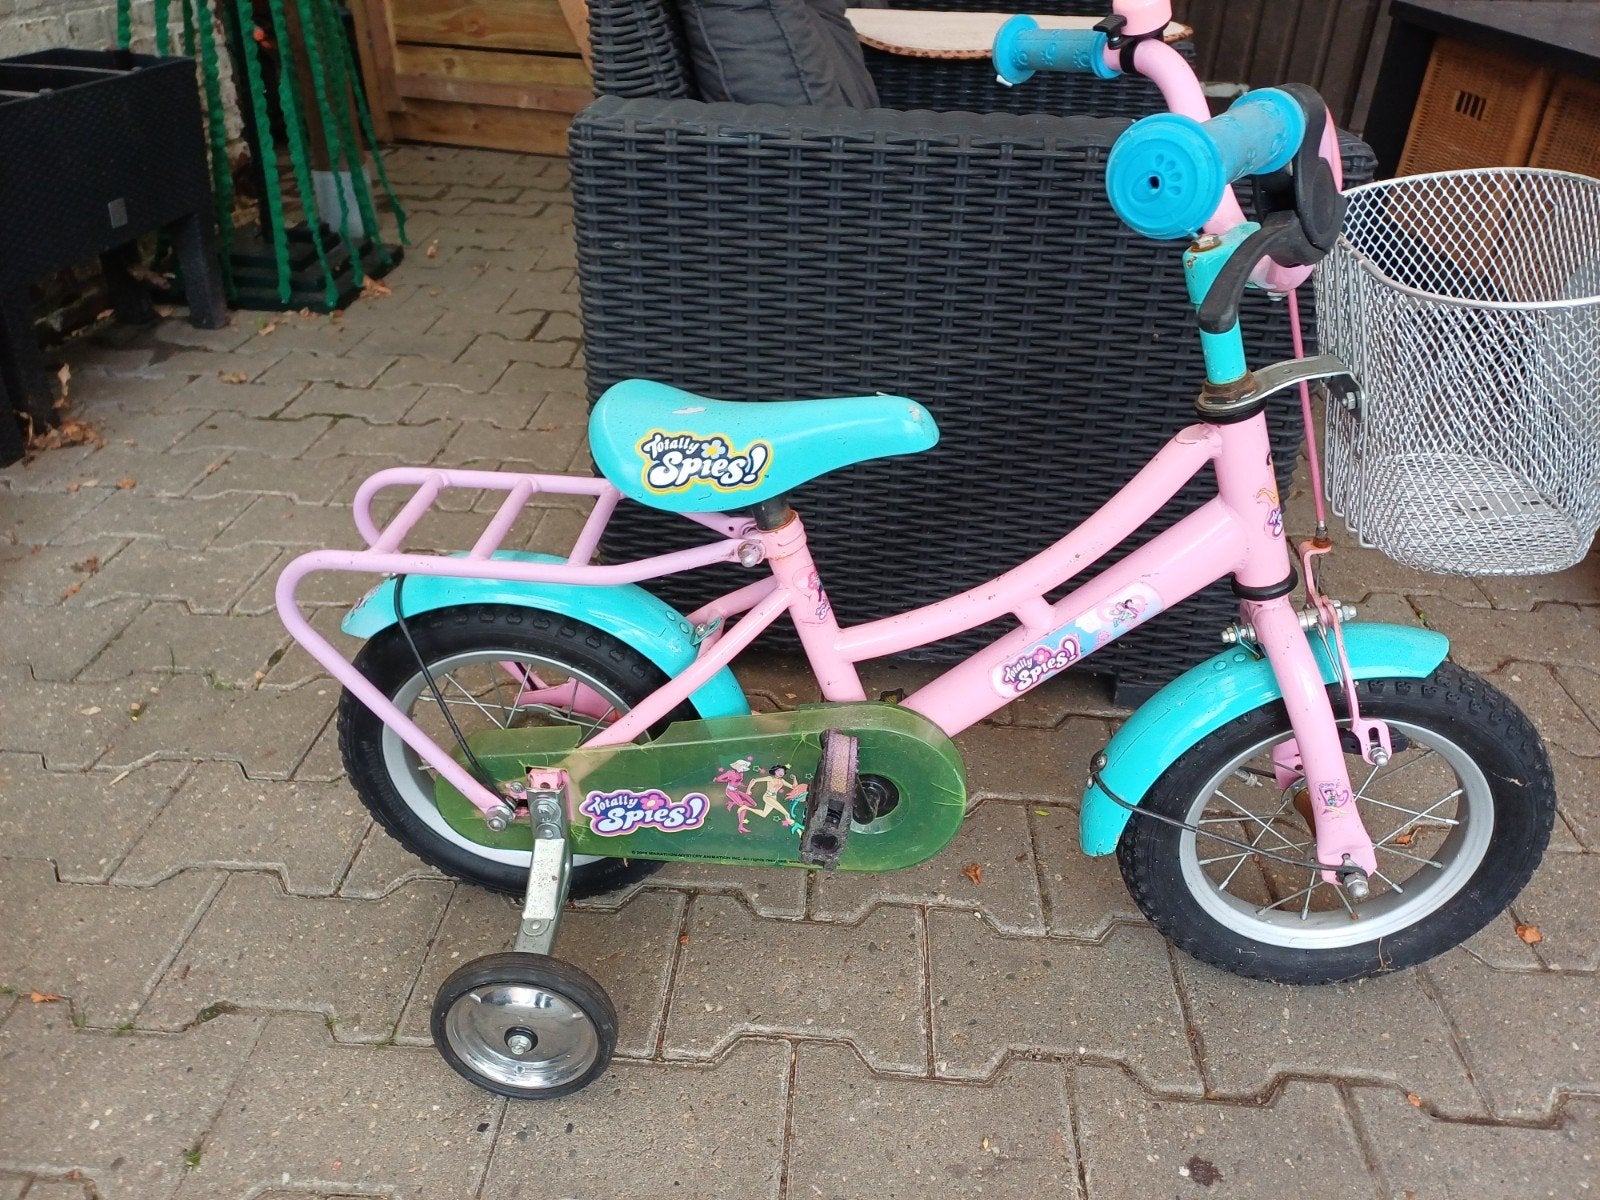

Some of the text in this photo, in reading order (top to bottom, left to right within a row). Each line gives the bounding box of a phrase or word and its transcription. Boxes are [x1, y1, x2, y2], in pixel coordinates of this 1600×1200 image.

[643, 433, 700, 458] Totally
[649, 446, 767, 486] Spies!
[1004, 656, 1033, 682] Totally
[1016, 640, 1076, 691] Spies!
[587, 796, 639, 815] Totally
[598, 798, 703, 832] Spies!
